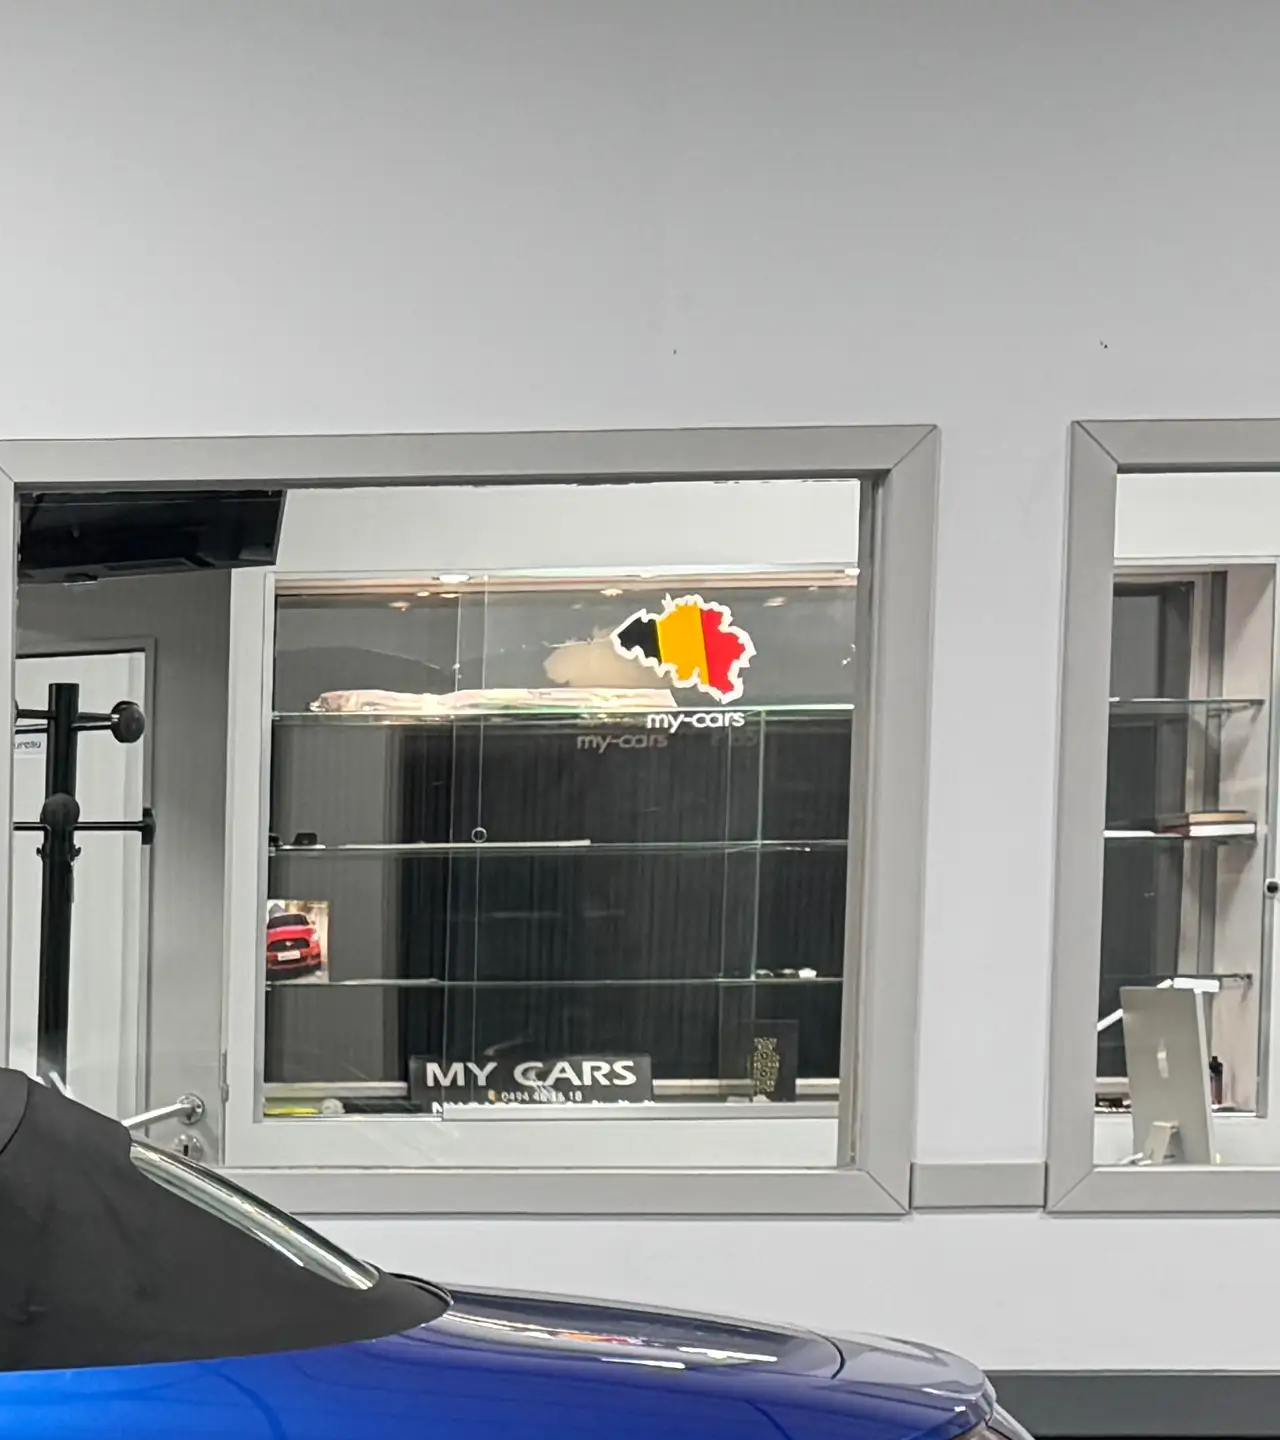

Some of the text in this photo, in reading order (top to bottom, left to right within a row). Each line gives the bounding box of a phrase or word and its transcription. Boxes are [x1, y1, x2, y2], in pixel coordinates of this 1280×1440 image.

[646, 711, 745, 734] my-cars
[425, 1060, 637, 1088] MY CARS
